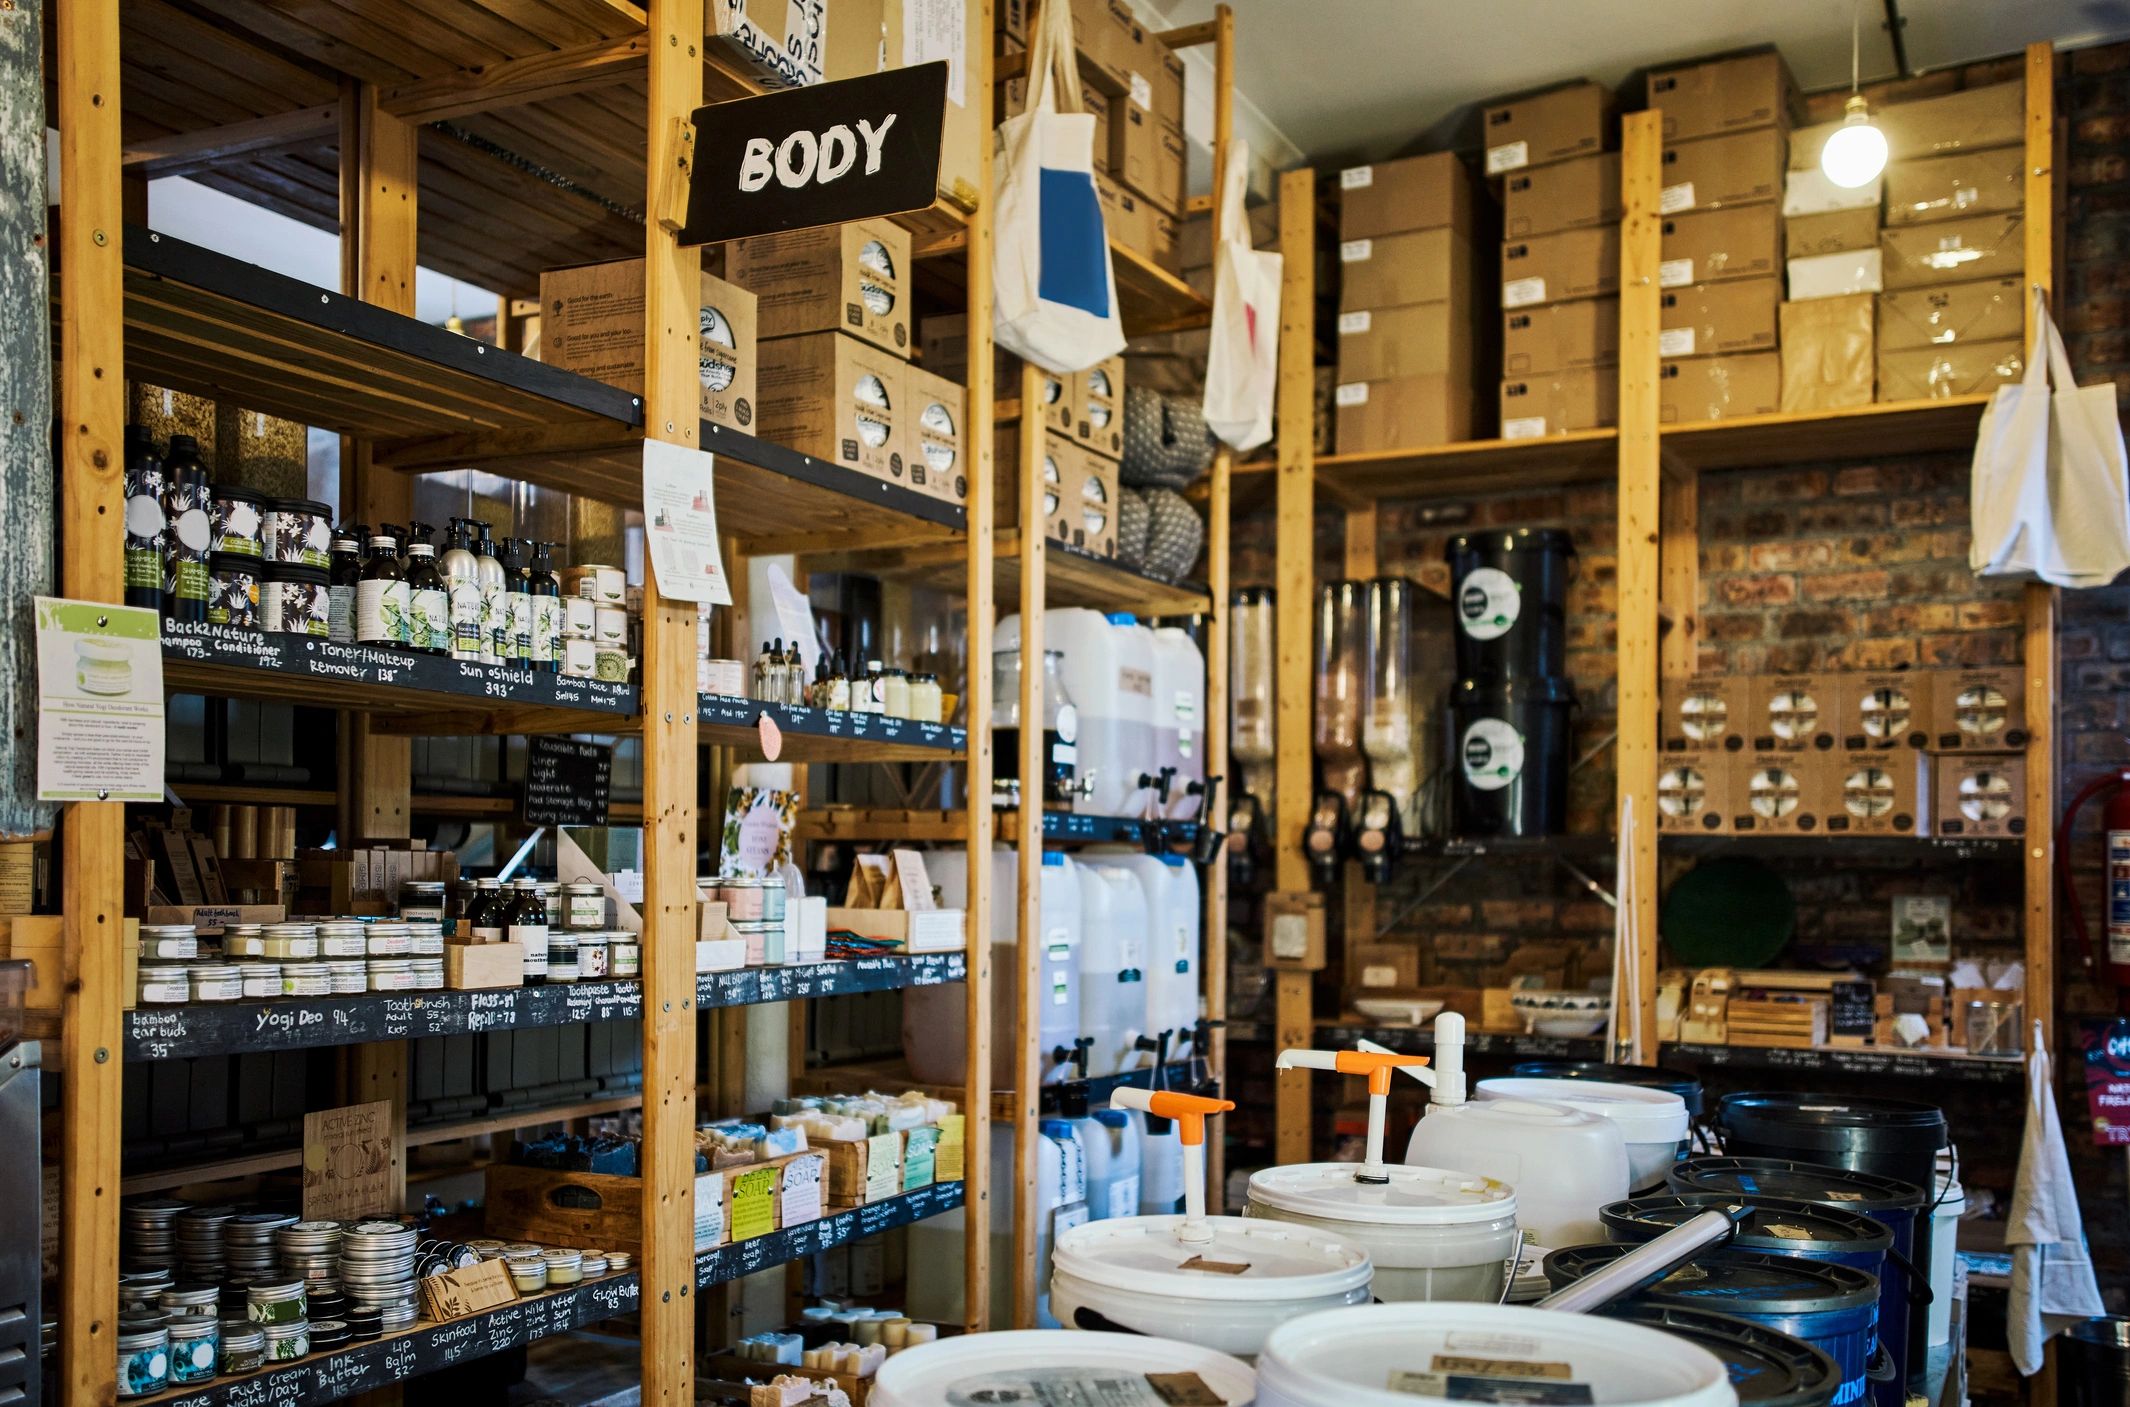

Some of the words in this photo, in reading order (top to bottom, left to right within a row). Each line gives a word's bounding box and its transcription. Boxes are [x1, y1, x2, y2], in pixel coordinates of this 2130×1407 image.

[739, 113, 897, 193] BODY
[214, 639, 281, 657] Conditioner
[319, 642, 415, 670] Toner/Makeup
[310, 659, 368, 678] Remover
[459, 663, 483, 679] Sun
[494, 668, 533, 685] Shield
[556, 675, 586, 690] Bamboo
[590, 680, 608, 693] Face
[533, 769, 556, 783] Light
[529, 783, 571, 793] Moderate
[196, 909, 214, 919] Adult
[568, 985, 609, 997] Toothpaste
[615, 983, 636, 994] Tooth
[132, 1012, 177, 1026] bamboo
[299, 1009, 324, 1026] Deo
[385, 1012, 412, 1022] Adult
[132, 1025, 155, 1039] ear
[160, 1022, 187, 1038] buds
[388, 1023, 408, 1036] Kids
[322, 1116, 352, 1132] ACTIVE
[354, 1111, 375, 1126] ZINC
[786, 1168, 818, 1189] SOAP
[738, 1180, 770, 1199] SOAP
[525, 1302, 545, 1316] Wild
[551, 1293, 578, 1309] After
[488, 1309, 521, 1328] Active
[553, 1308, 572, 1320] Sun
[431, 1320, 477, 1347] Skinfood
[392, 1340, 412, 1354] Lip
[329, 1354, 351, 1370] Ink
[385, 1353, 417, 1370] Balm
[229, 1379, 262, 1400] Face
[269, 1367, 311, 1388] Cream
[318, 1364, 370, 1388] Butter
